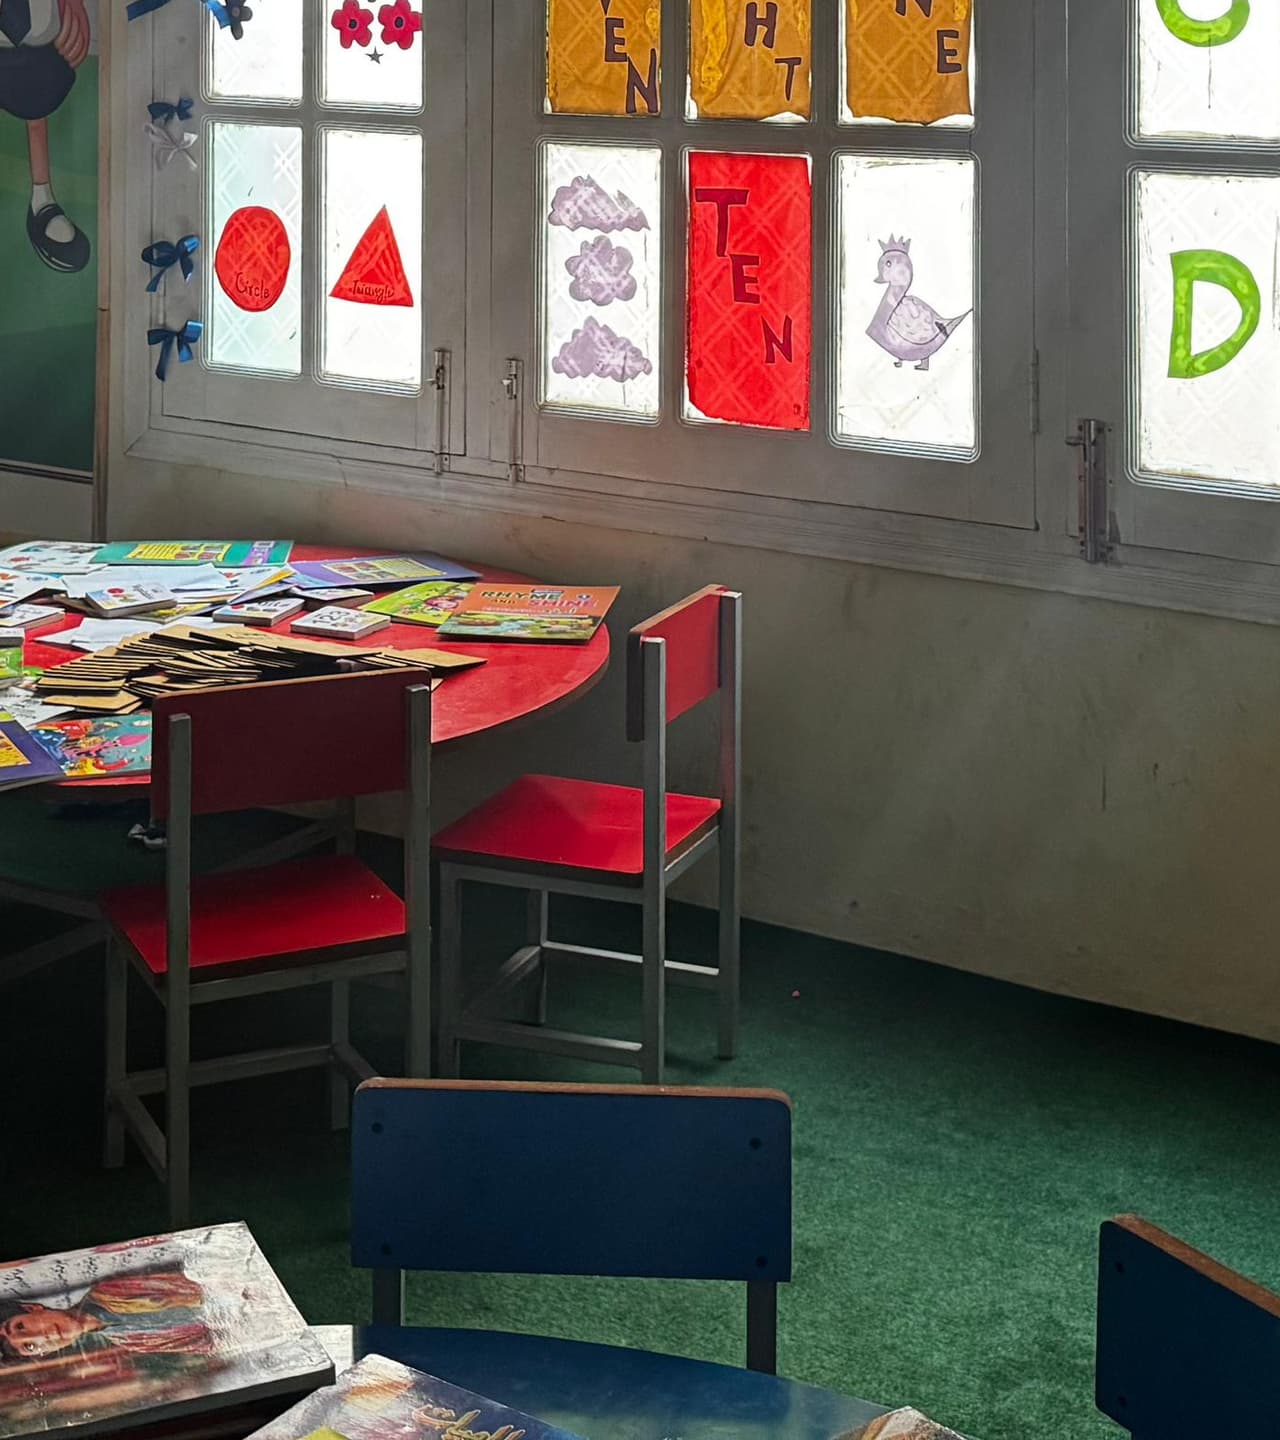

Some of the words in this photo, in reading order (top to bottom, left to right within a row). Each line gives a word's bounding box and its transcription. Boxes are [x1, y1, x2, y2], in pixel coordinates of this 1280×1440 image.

[235, 272, 270, 299] Circle
[696, 188, 792, 363] TEN
[1167, 249, 1261, 378] D
[481, 591, 561, 601] RHYME
